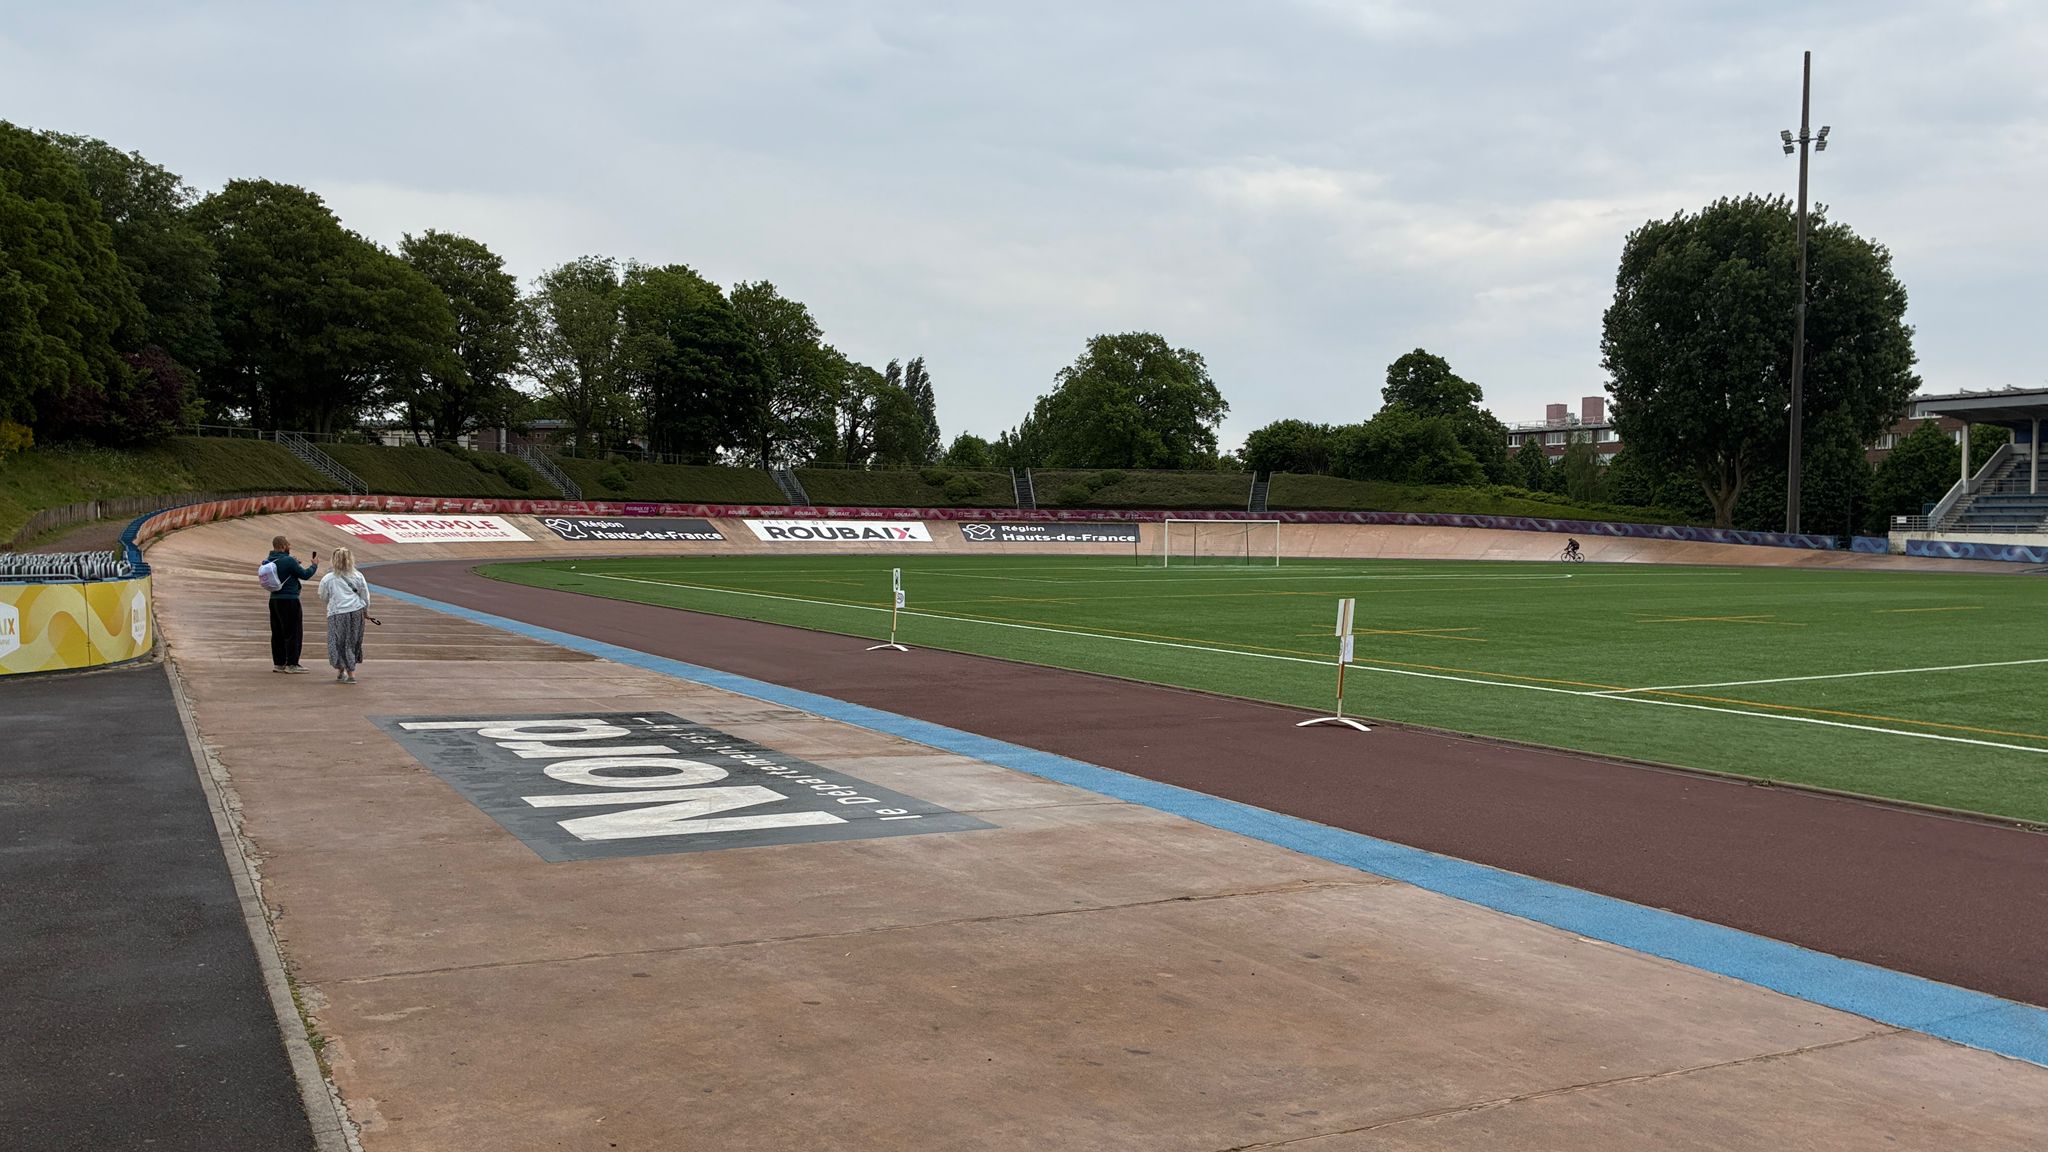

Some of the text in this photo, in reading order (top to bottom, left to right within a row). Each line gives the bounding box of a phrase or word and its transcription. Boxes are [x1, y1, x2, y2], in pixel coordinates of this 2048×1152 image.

[373, 517, 500, 530] MÉTROPOLE
[578, 520, 625, 530] Région
[1001, 525, 1045, 533] Région
[590, 530, 723, 541] Hauts-de-France
[763, 526, 918, 540] ROUBAIX
[1002, 533, 1136, 542] Hauts-de-France
[670, 732, 717, 744] est
[398, 718, 850, 841] Nord
[702, 746, 881, 805] Département
[874, 808, 923, 821] le
